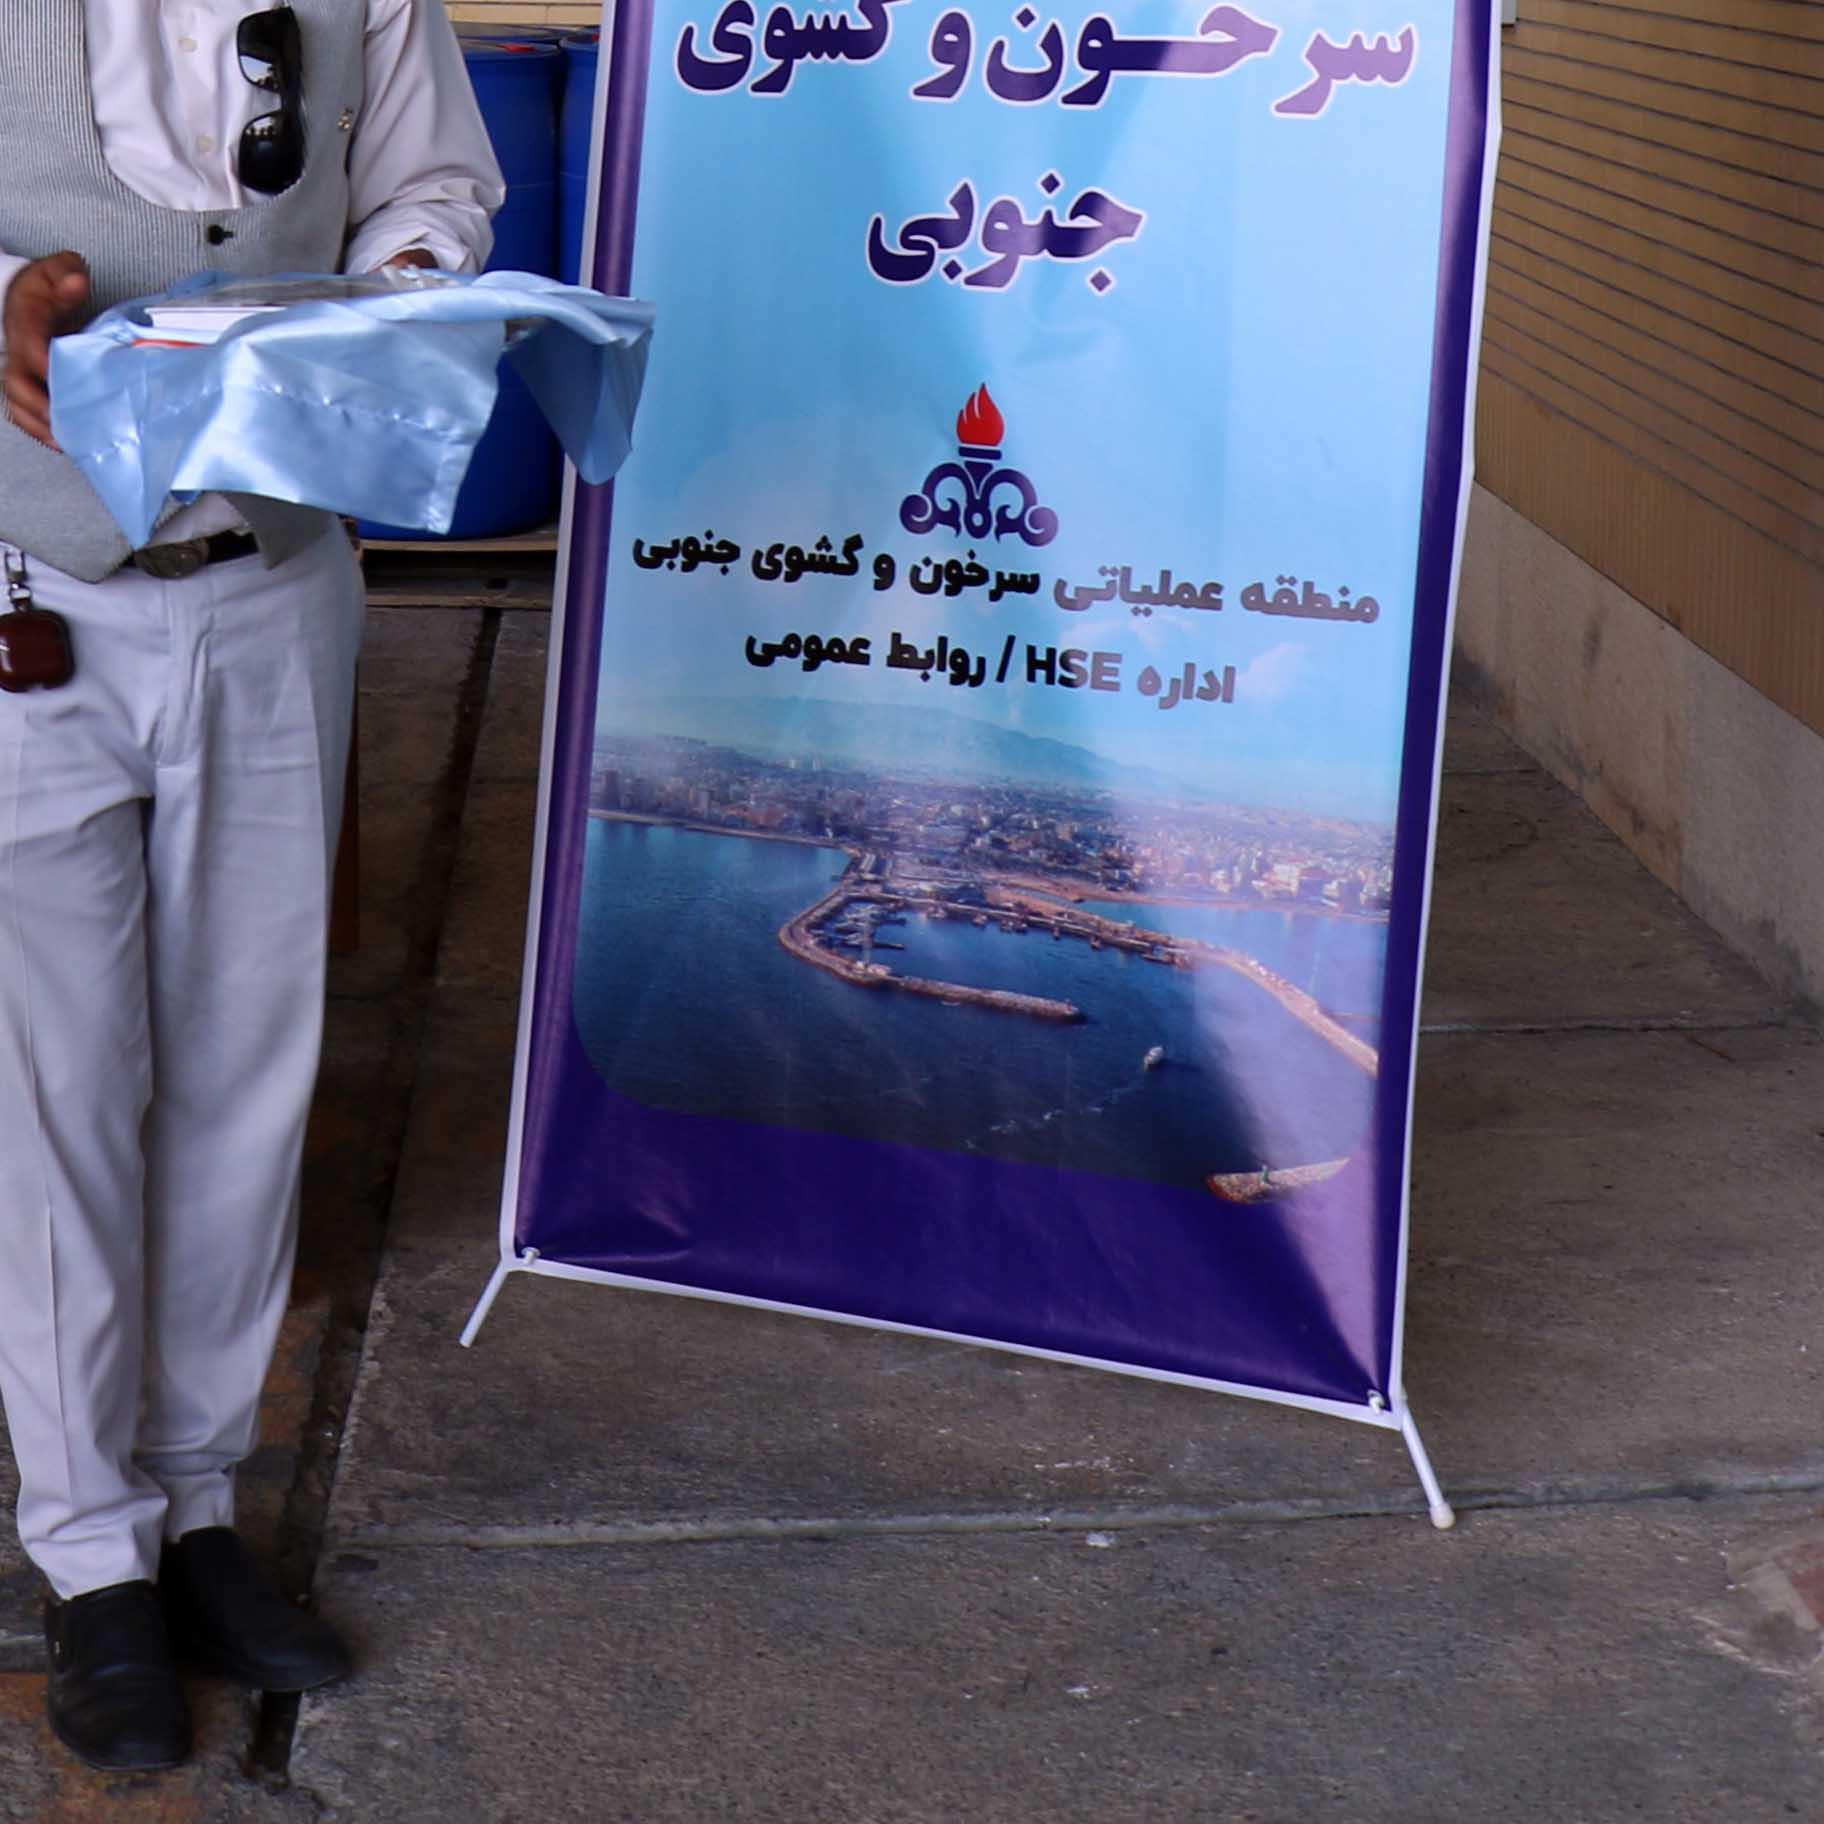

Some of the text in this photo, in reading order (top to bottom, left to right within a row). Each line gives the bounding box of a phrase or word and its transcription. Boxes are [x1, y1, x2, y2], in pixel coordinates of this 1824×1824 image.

[913, 10, 973, 99] و
[867, 173, 1143, 293] جنوبی
[633, 529, 1380, 623] منطقه عملیاتی سرخون و گشوی جنوبی
[745, 632, 1236, 710] اداره HSE / روابط عمومی
